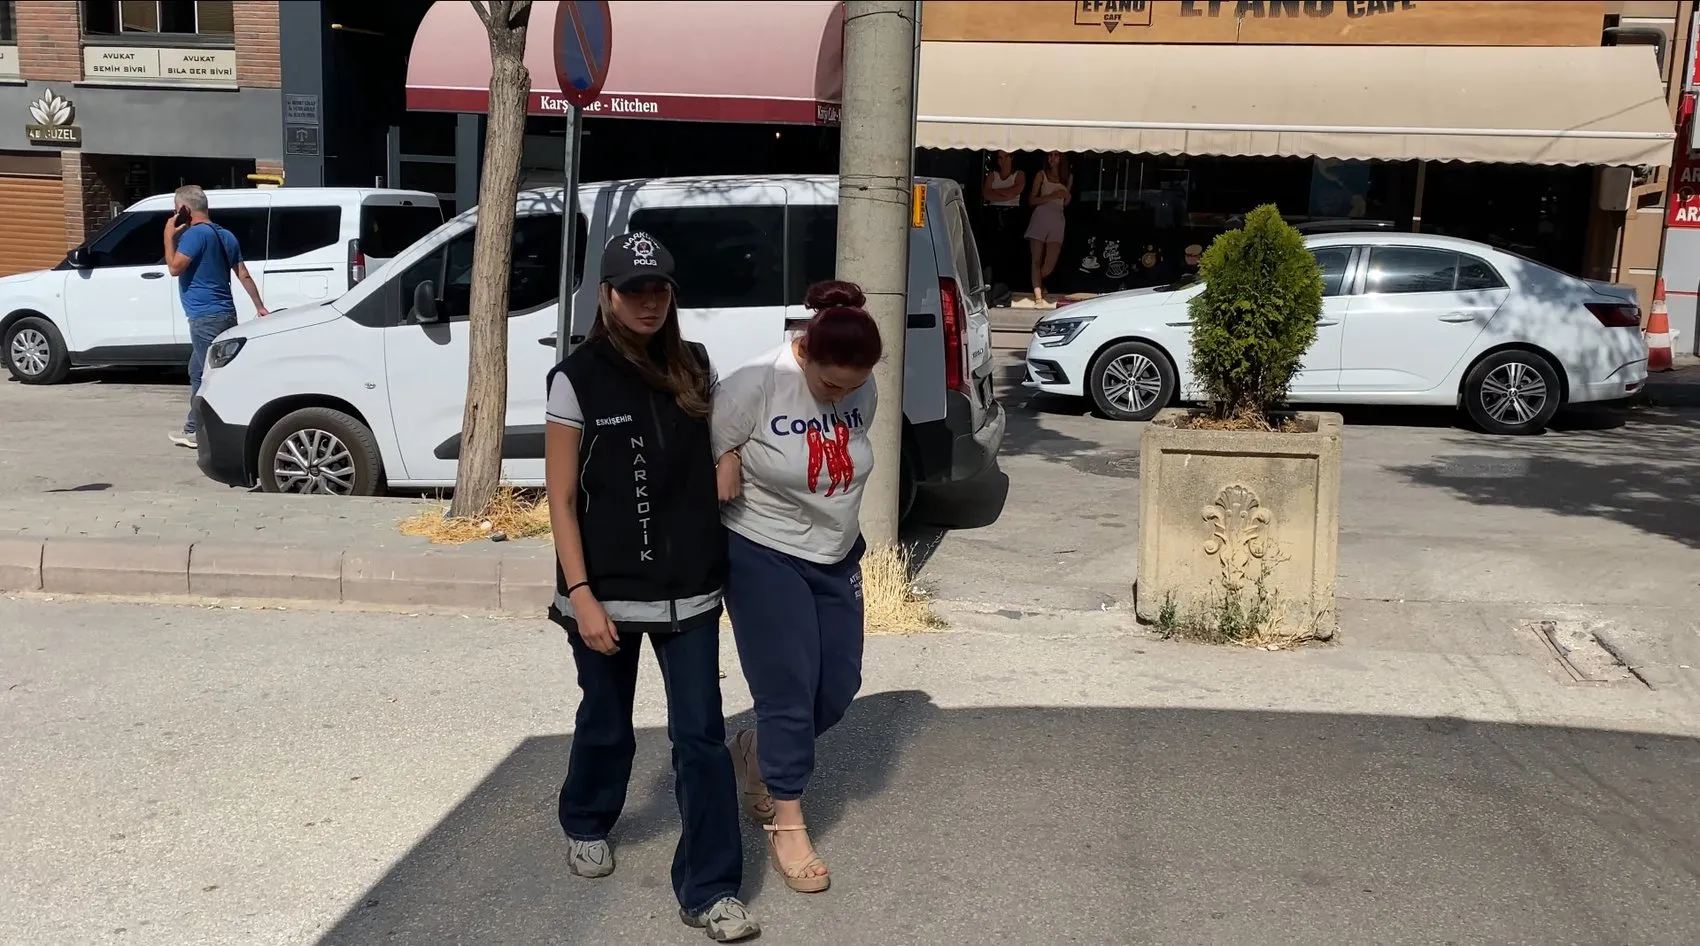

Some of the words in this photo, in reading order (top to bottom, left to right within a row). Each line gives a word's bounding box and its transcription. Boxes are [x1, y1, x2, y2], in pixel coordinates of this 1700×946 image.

[1346, 1, 1417, 19] CA
[541, 95, 569, 113] Karş
[611, 97, 658, 113] Kitchen
[1674, 206, 1700, 222] AR
[595, 413, 633, 426] ESKİŞEHİR
[770, 413, 830, 436] Cool
[630, 436, 654, 561] NARKOTİK
